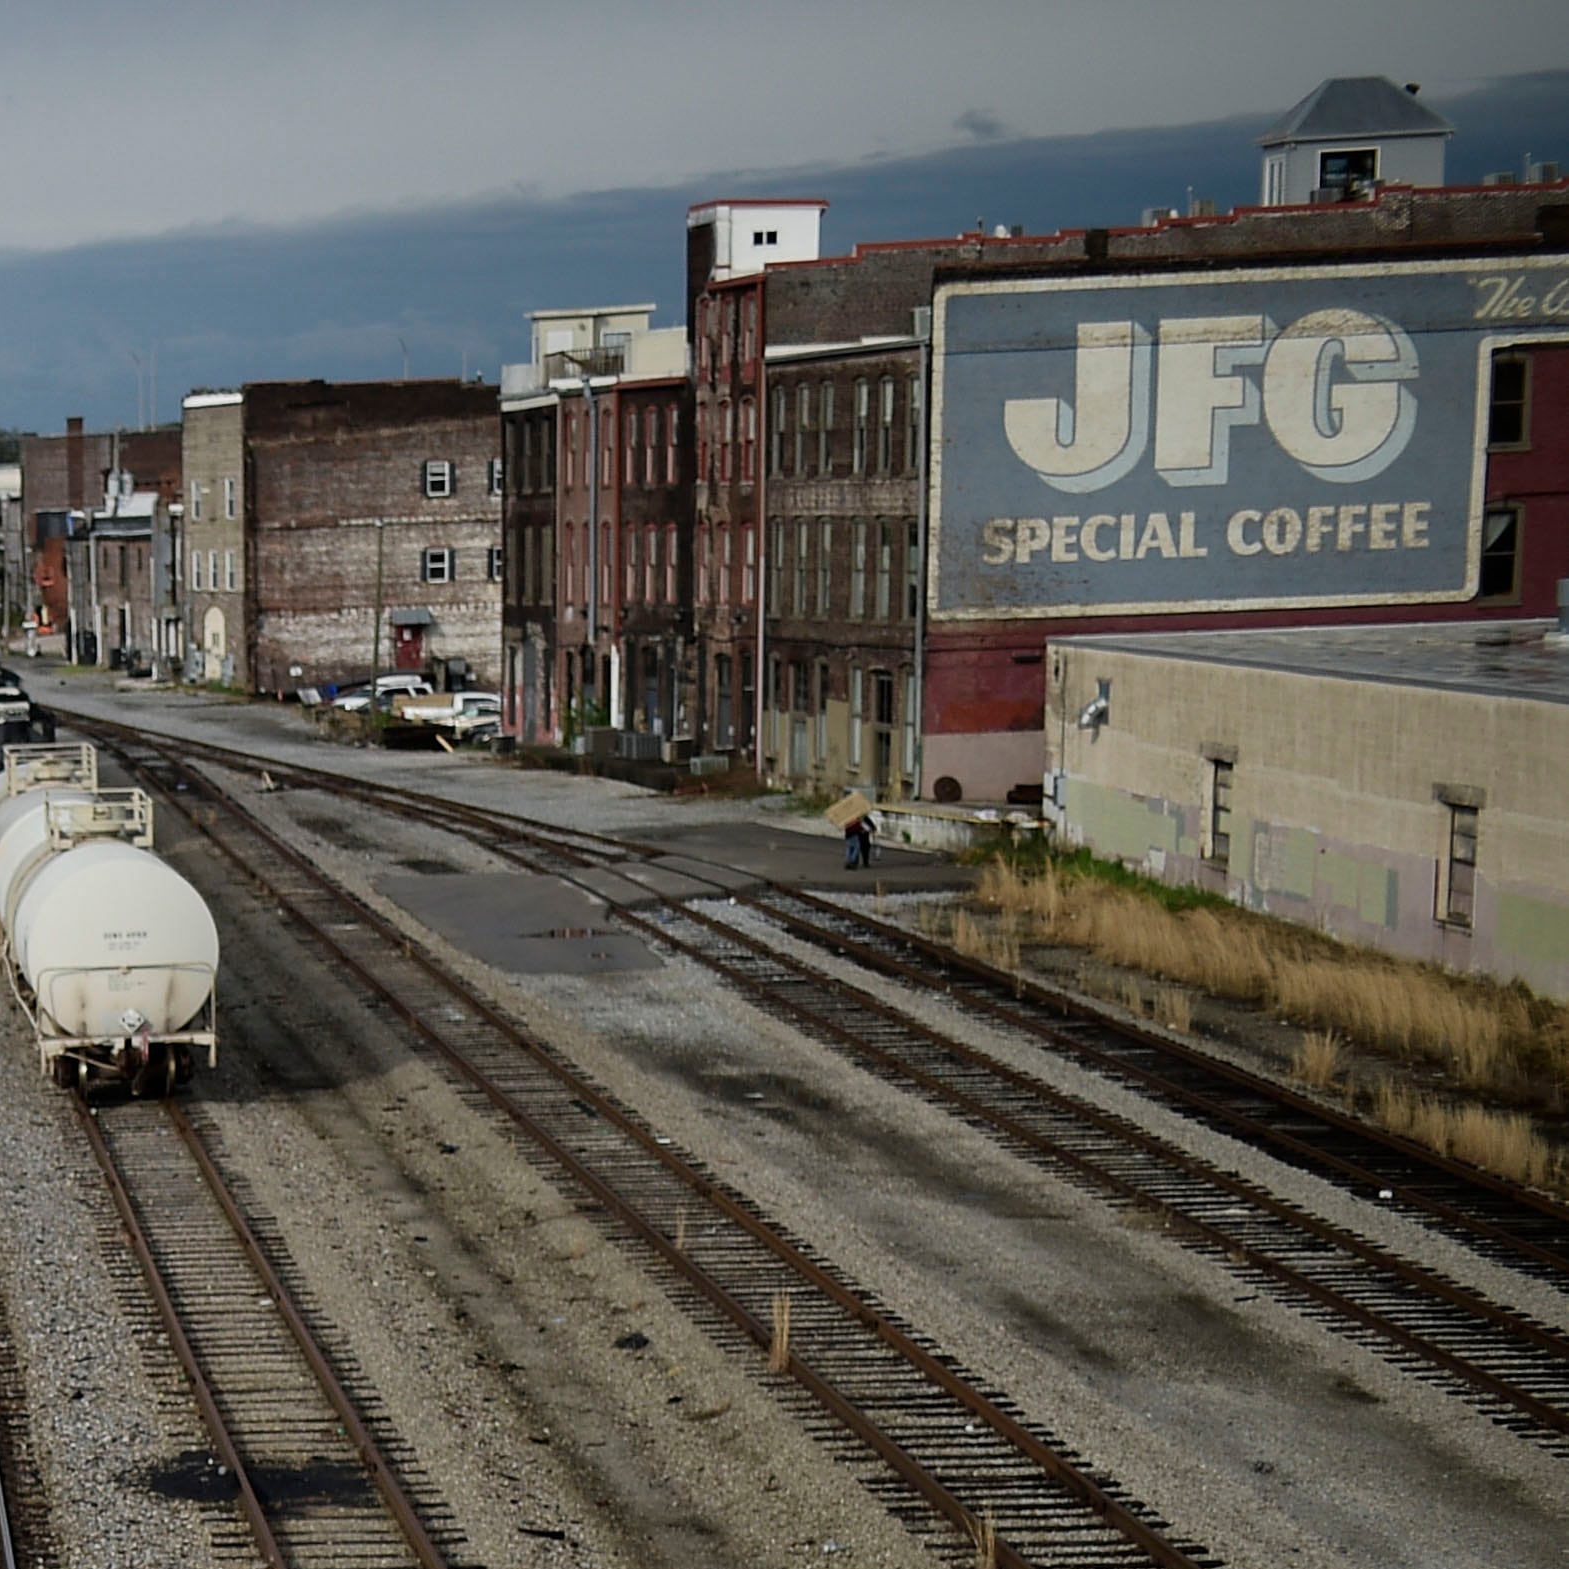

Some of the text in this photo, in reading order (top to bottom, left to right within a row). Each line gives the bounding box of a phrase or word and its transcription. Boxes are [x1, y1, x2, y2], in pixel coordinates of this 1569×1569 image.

[1003, 308, 1420, 494] JFG
[982, 501, 1433, 566] SPECIAL COFFEE
